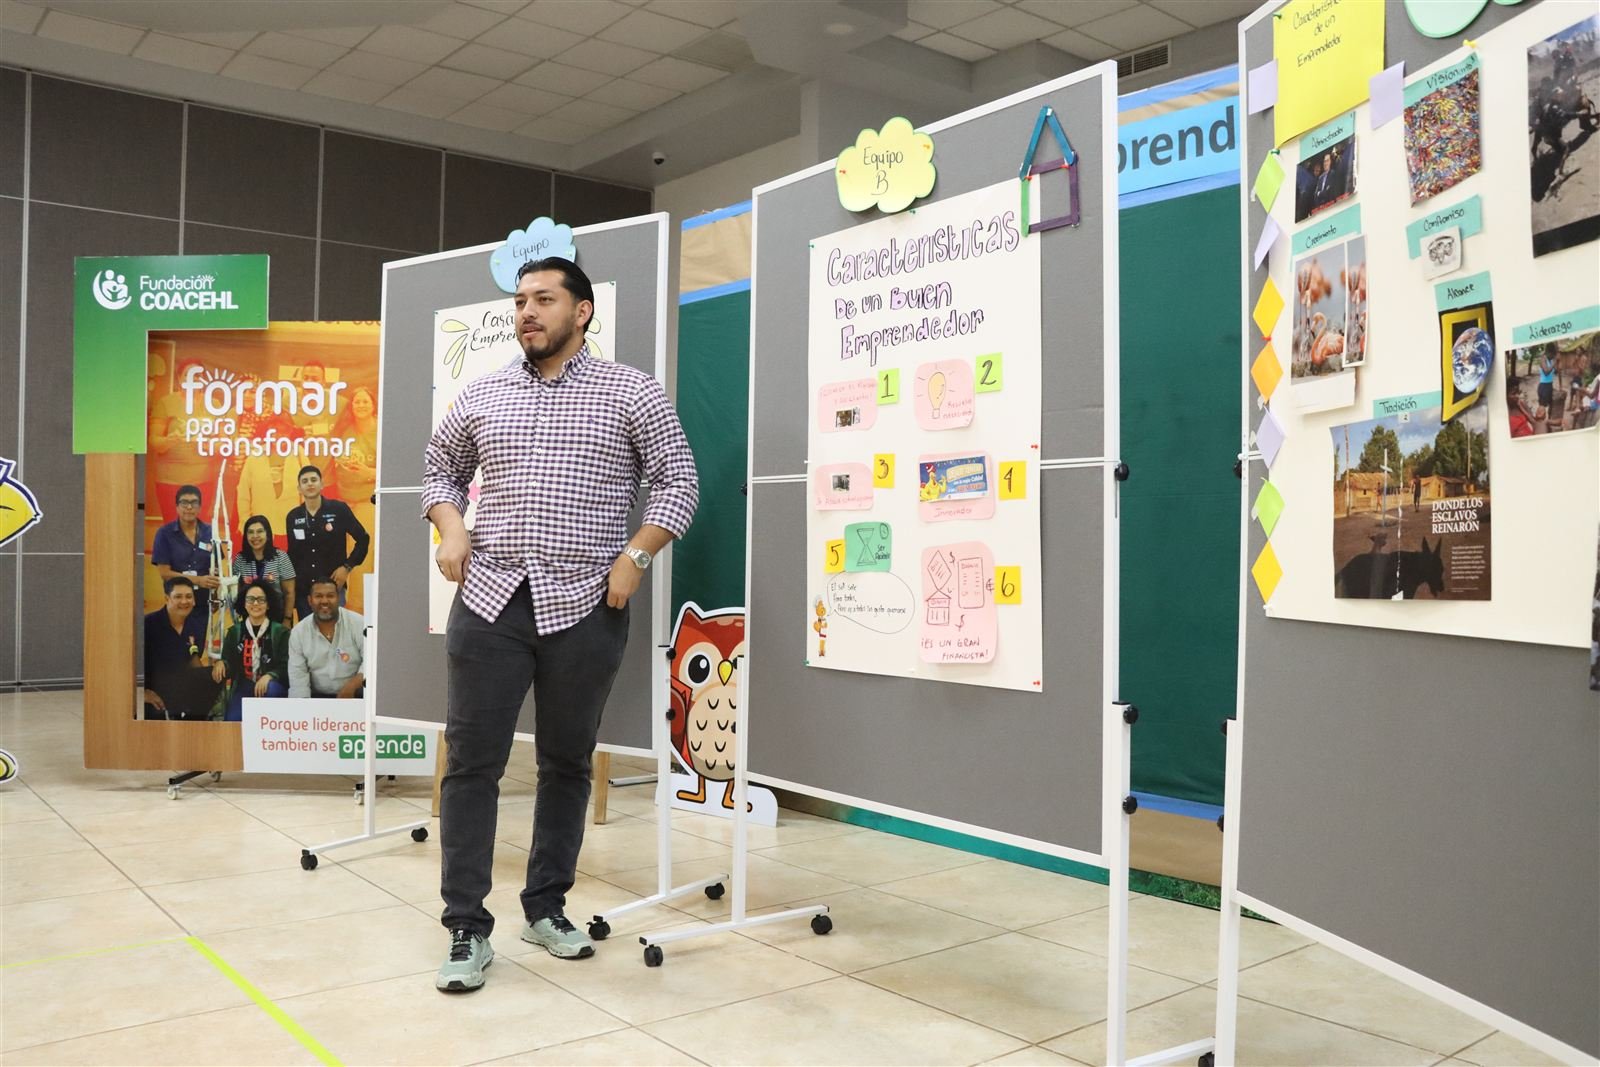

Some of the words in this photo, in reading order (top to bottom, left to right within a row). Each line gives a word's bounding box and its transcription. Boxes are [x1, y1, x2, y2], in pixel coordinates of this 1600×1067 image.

[1324, 14, 1336, 28] un
[863, 146, 905, 171] Equipo
[871, 171, 889, 196] B
[512, 238, 550, 261] Equipo
[140, 275, 213, 291] Fundación
[140, 291, 239, 311] COACEHL
[835, 298, 857, 320] De
[861, 293, 882, 314] un
[890, 281, 953, 311] Buen
[840, 308, 985, 368] Emprendedor
[1528, 320, 1573, 340] Liderazgo
[979, 359, 997, 386] 2
[181, 365, 347, 416] formar
[880, 373, 895, 399] 1
[1378, 397, 1418, 414] Tradición
[185, 417, 236, 442] para
[196, 428, 356, 457] transformar
[877, 459, 890, 481] 3
[1003, 466, 1014, 493] 4
[1431, 498, 1465, 512] DONDE
[1466, 496, 1484, 509] LOS
[1431, 509, 1478, 523] ESCLAVOS
[1431, 520, 1480, 534] REINARON
[829, 543, 843, 567] 5
[1000, 571, 1016, 598] 6
[939, 639, 952, 648] UN
[957, 635, 980, 648] GRAN
[260, 716, 309, 734] Porque
[262, 737, 317, 752] tambien
[322, 740, 336, 752] se
[342, 734, 424, 760] apende
